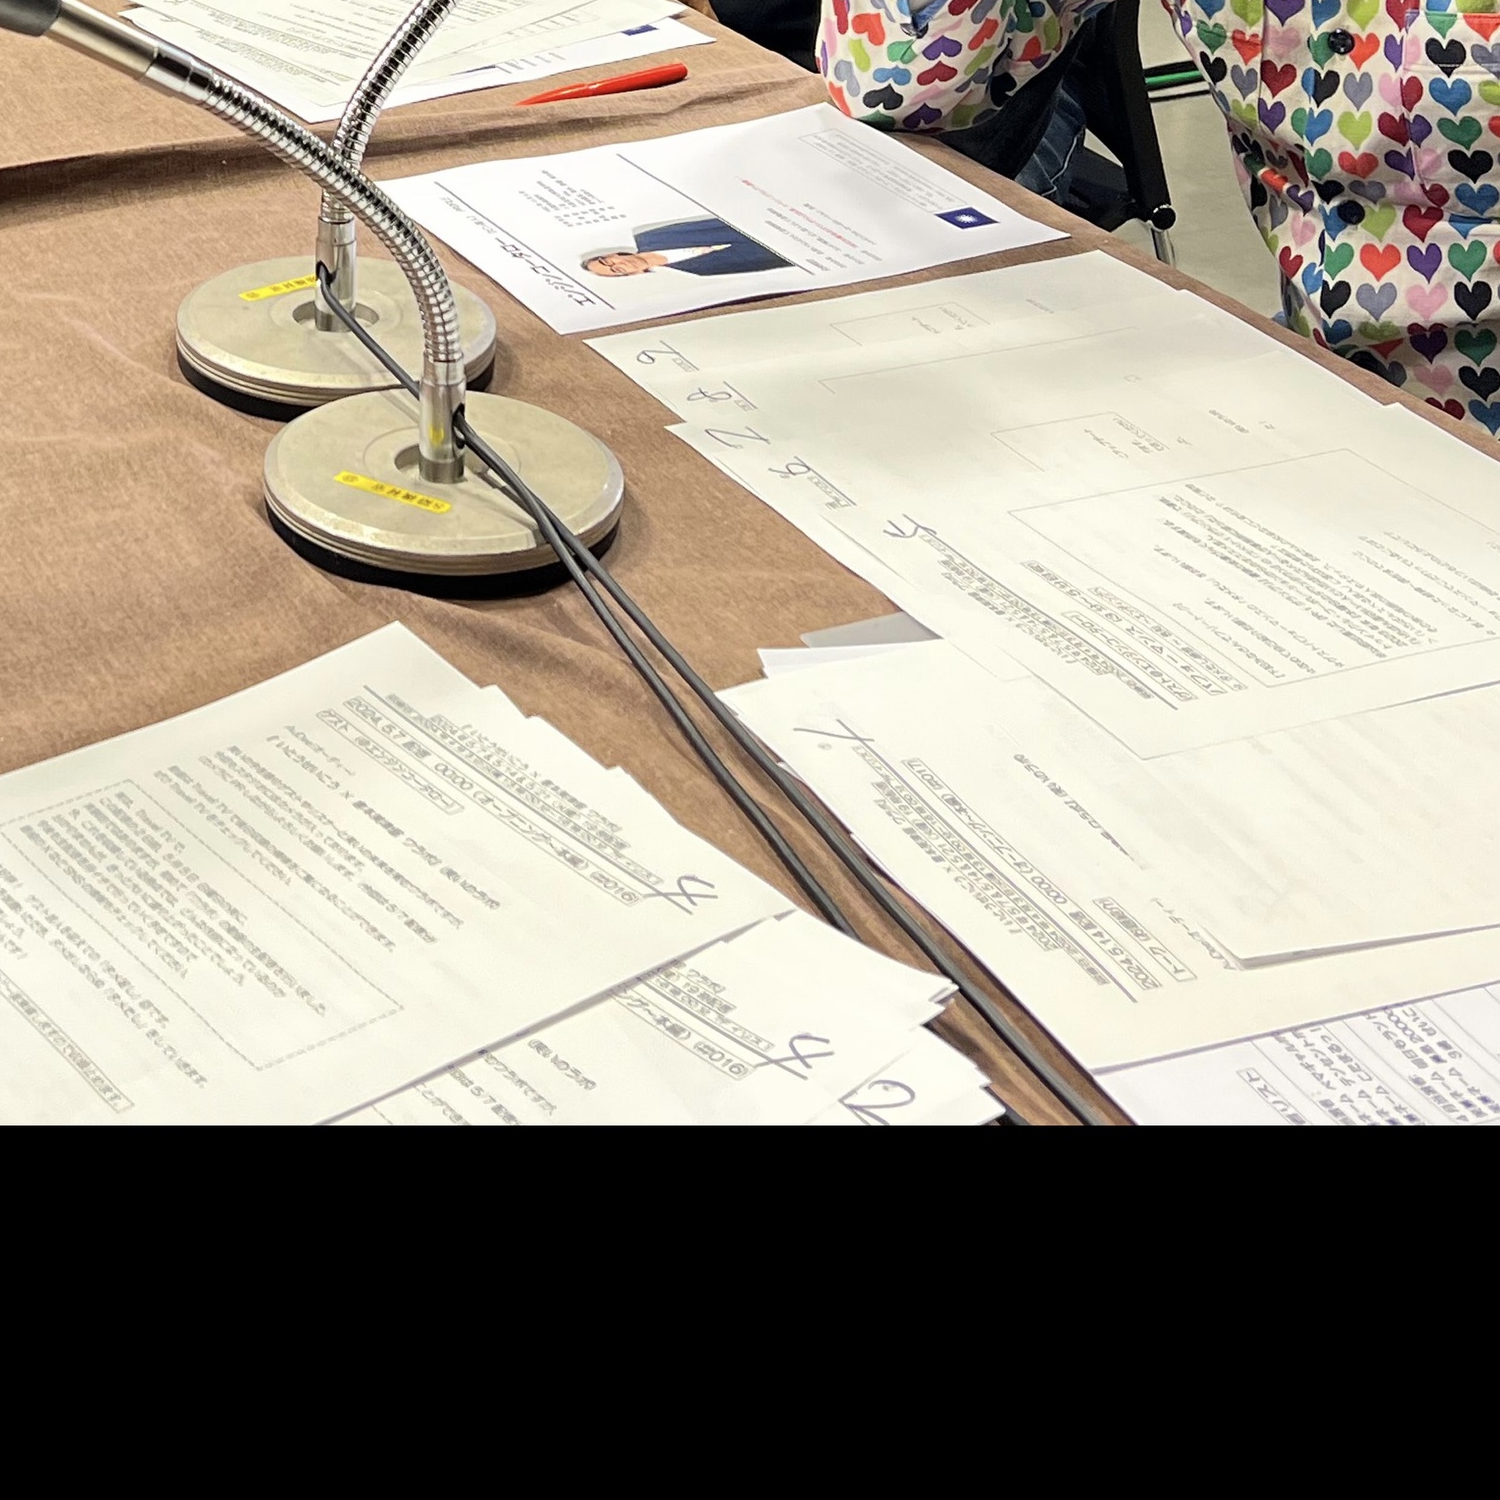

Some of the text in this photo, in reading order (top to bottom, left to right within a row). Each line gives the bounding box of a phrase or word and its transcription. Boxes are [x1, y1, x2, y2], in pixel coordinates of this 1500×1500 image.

[1147, 941, 1185, 977] トーク
[1237, 1066, 1308, 1124] リスト
